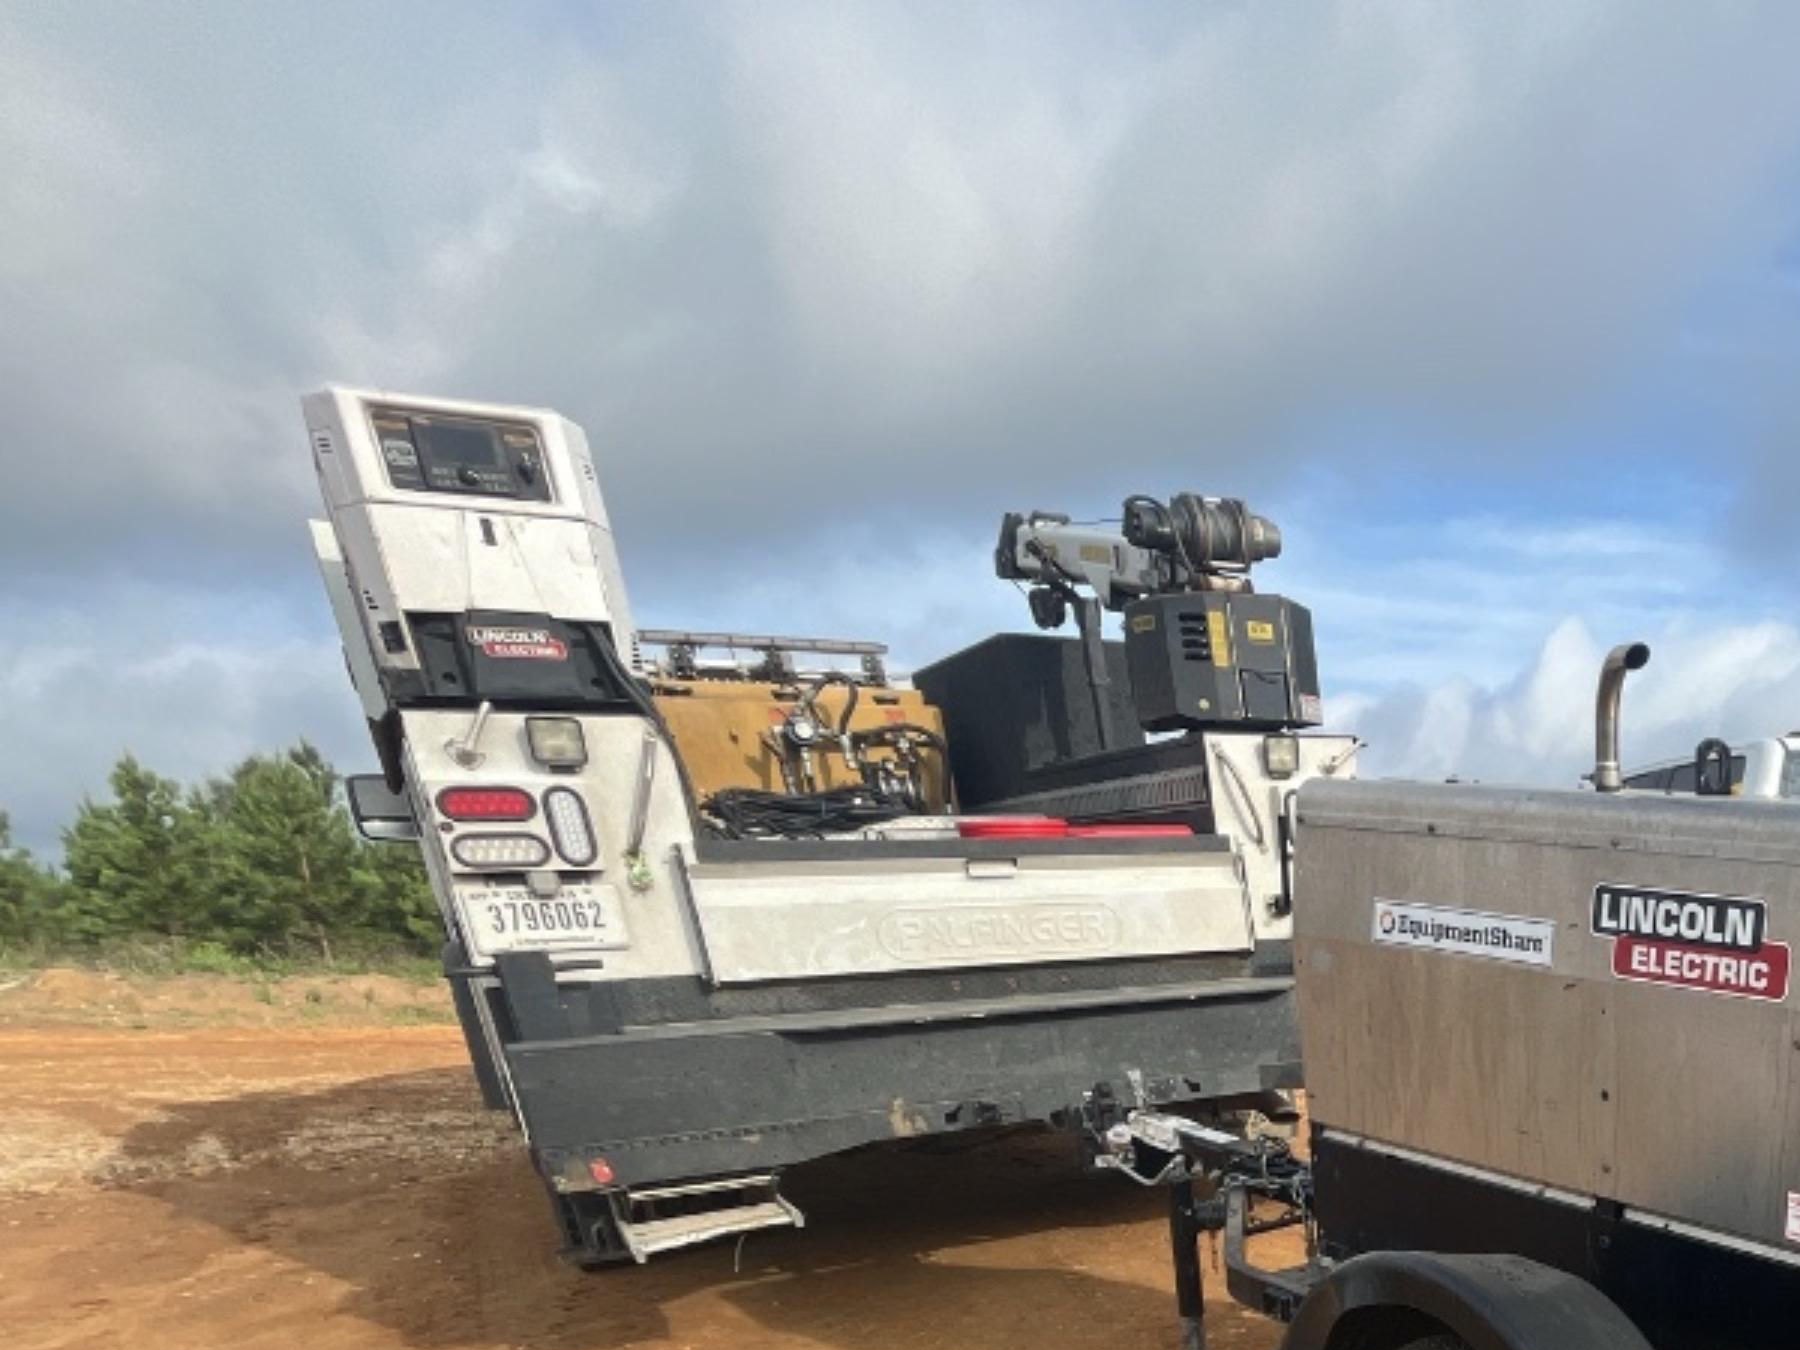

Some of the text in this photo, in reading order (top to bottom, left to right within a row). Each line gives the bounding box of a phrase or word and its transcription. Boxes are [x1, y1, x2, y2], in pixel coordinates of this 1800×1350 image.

[488, 901, 607, 933] 3796062
[1398, 914, 1543, 952] EquipmentShare
[1600, 893, 1756, 947] LINCOLN
[1631, 944, 1769, 990] ELECTRIC
